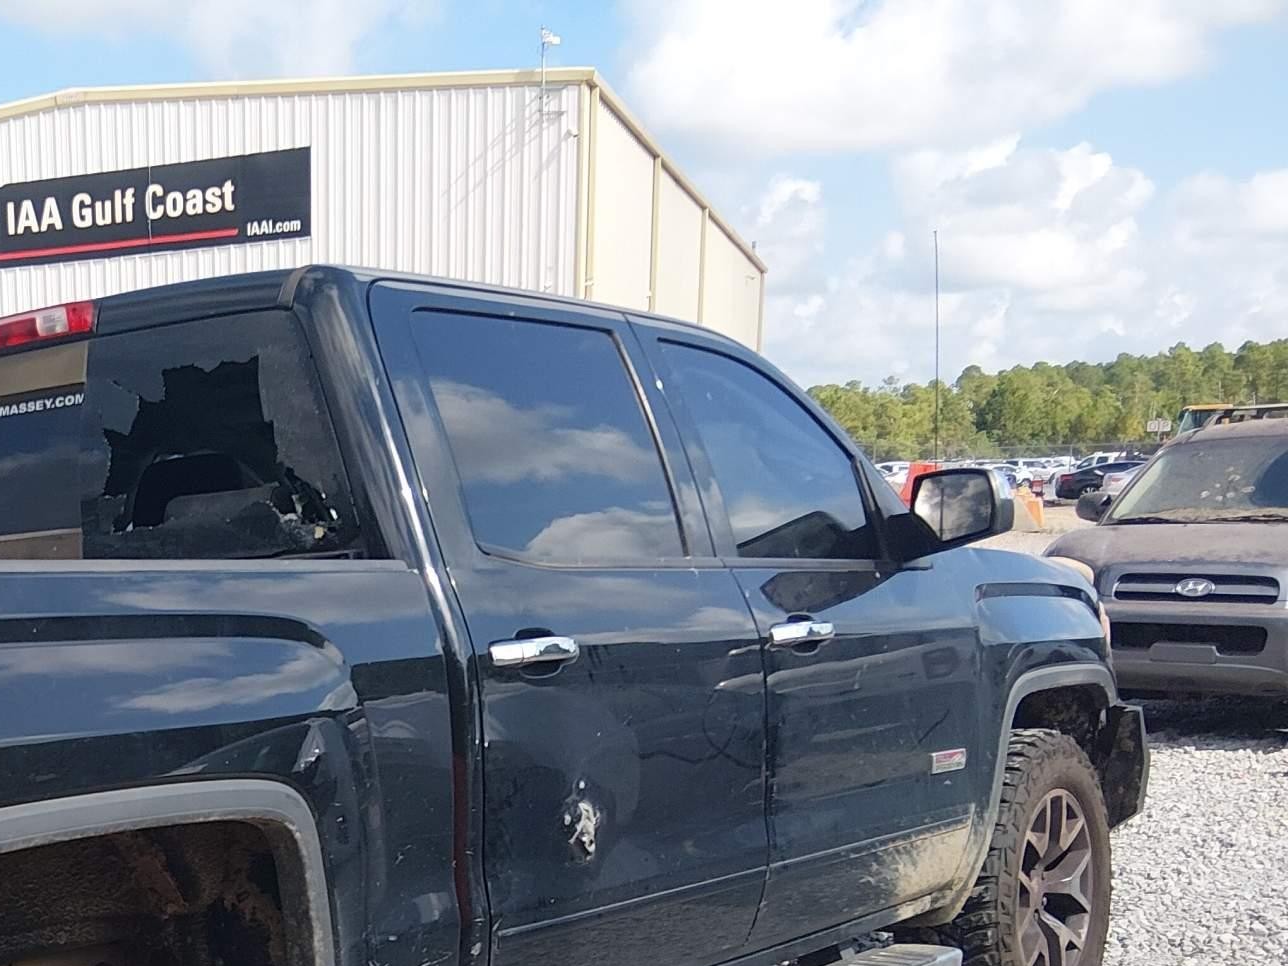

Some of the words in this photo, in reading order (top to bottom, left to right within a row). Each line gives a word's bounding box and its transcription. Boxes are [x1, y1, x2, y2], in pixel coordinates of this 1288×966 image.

[6, 196, 63, 235] IAA
[72, 187, 135, 228] Gulf
[145, 179, 235, 220] Coast
[247, 219, 301, 236] IAAI.com
